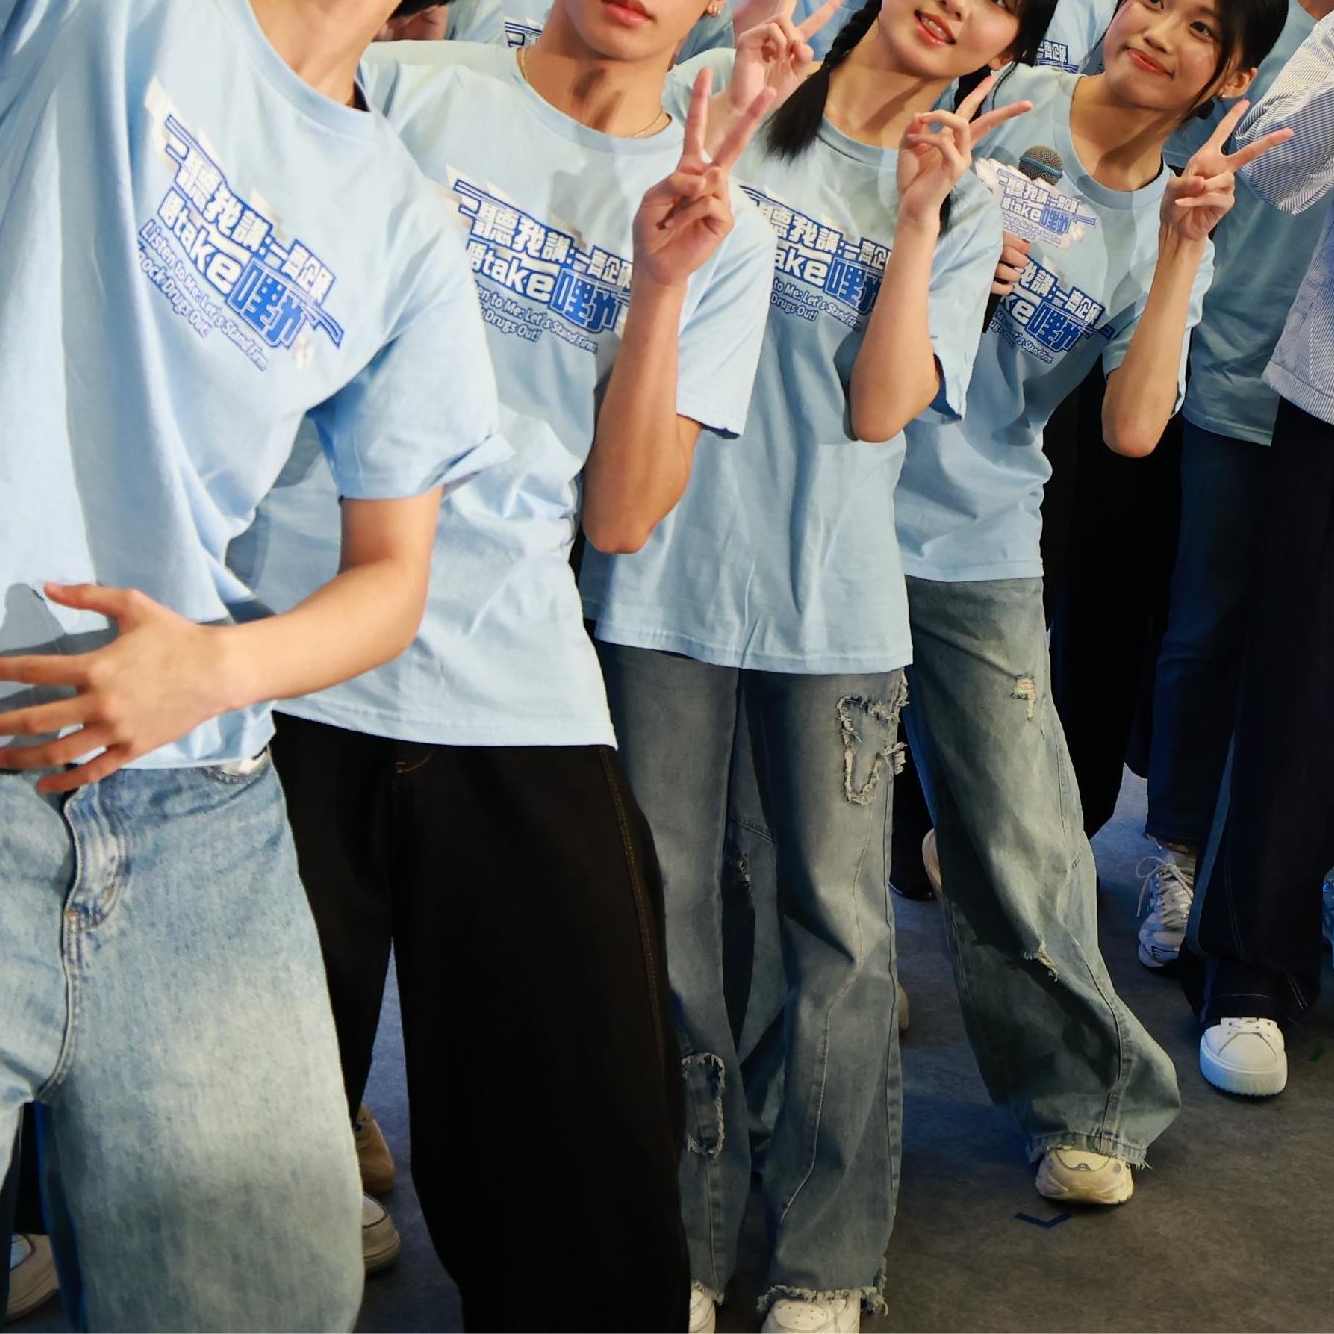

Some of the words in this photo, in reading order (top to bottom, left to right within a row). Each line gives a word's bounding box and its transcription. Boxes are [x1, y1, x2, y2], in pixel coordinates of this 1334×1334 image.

[140, 219, 177, 267] Listen
[162, 277, 190, 316] Drugs
[490, 292, 503, 308] to
[503, 298, 525, 318] Me:
[770, 292, 796, 314] Drugs
[796, 305, 819, 322] Out!
[784, 283, 802, 301] Me:
[485, 309, 517, 333] Drugs
[517, 323, 543, 343] Out!
